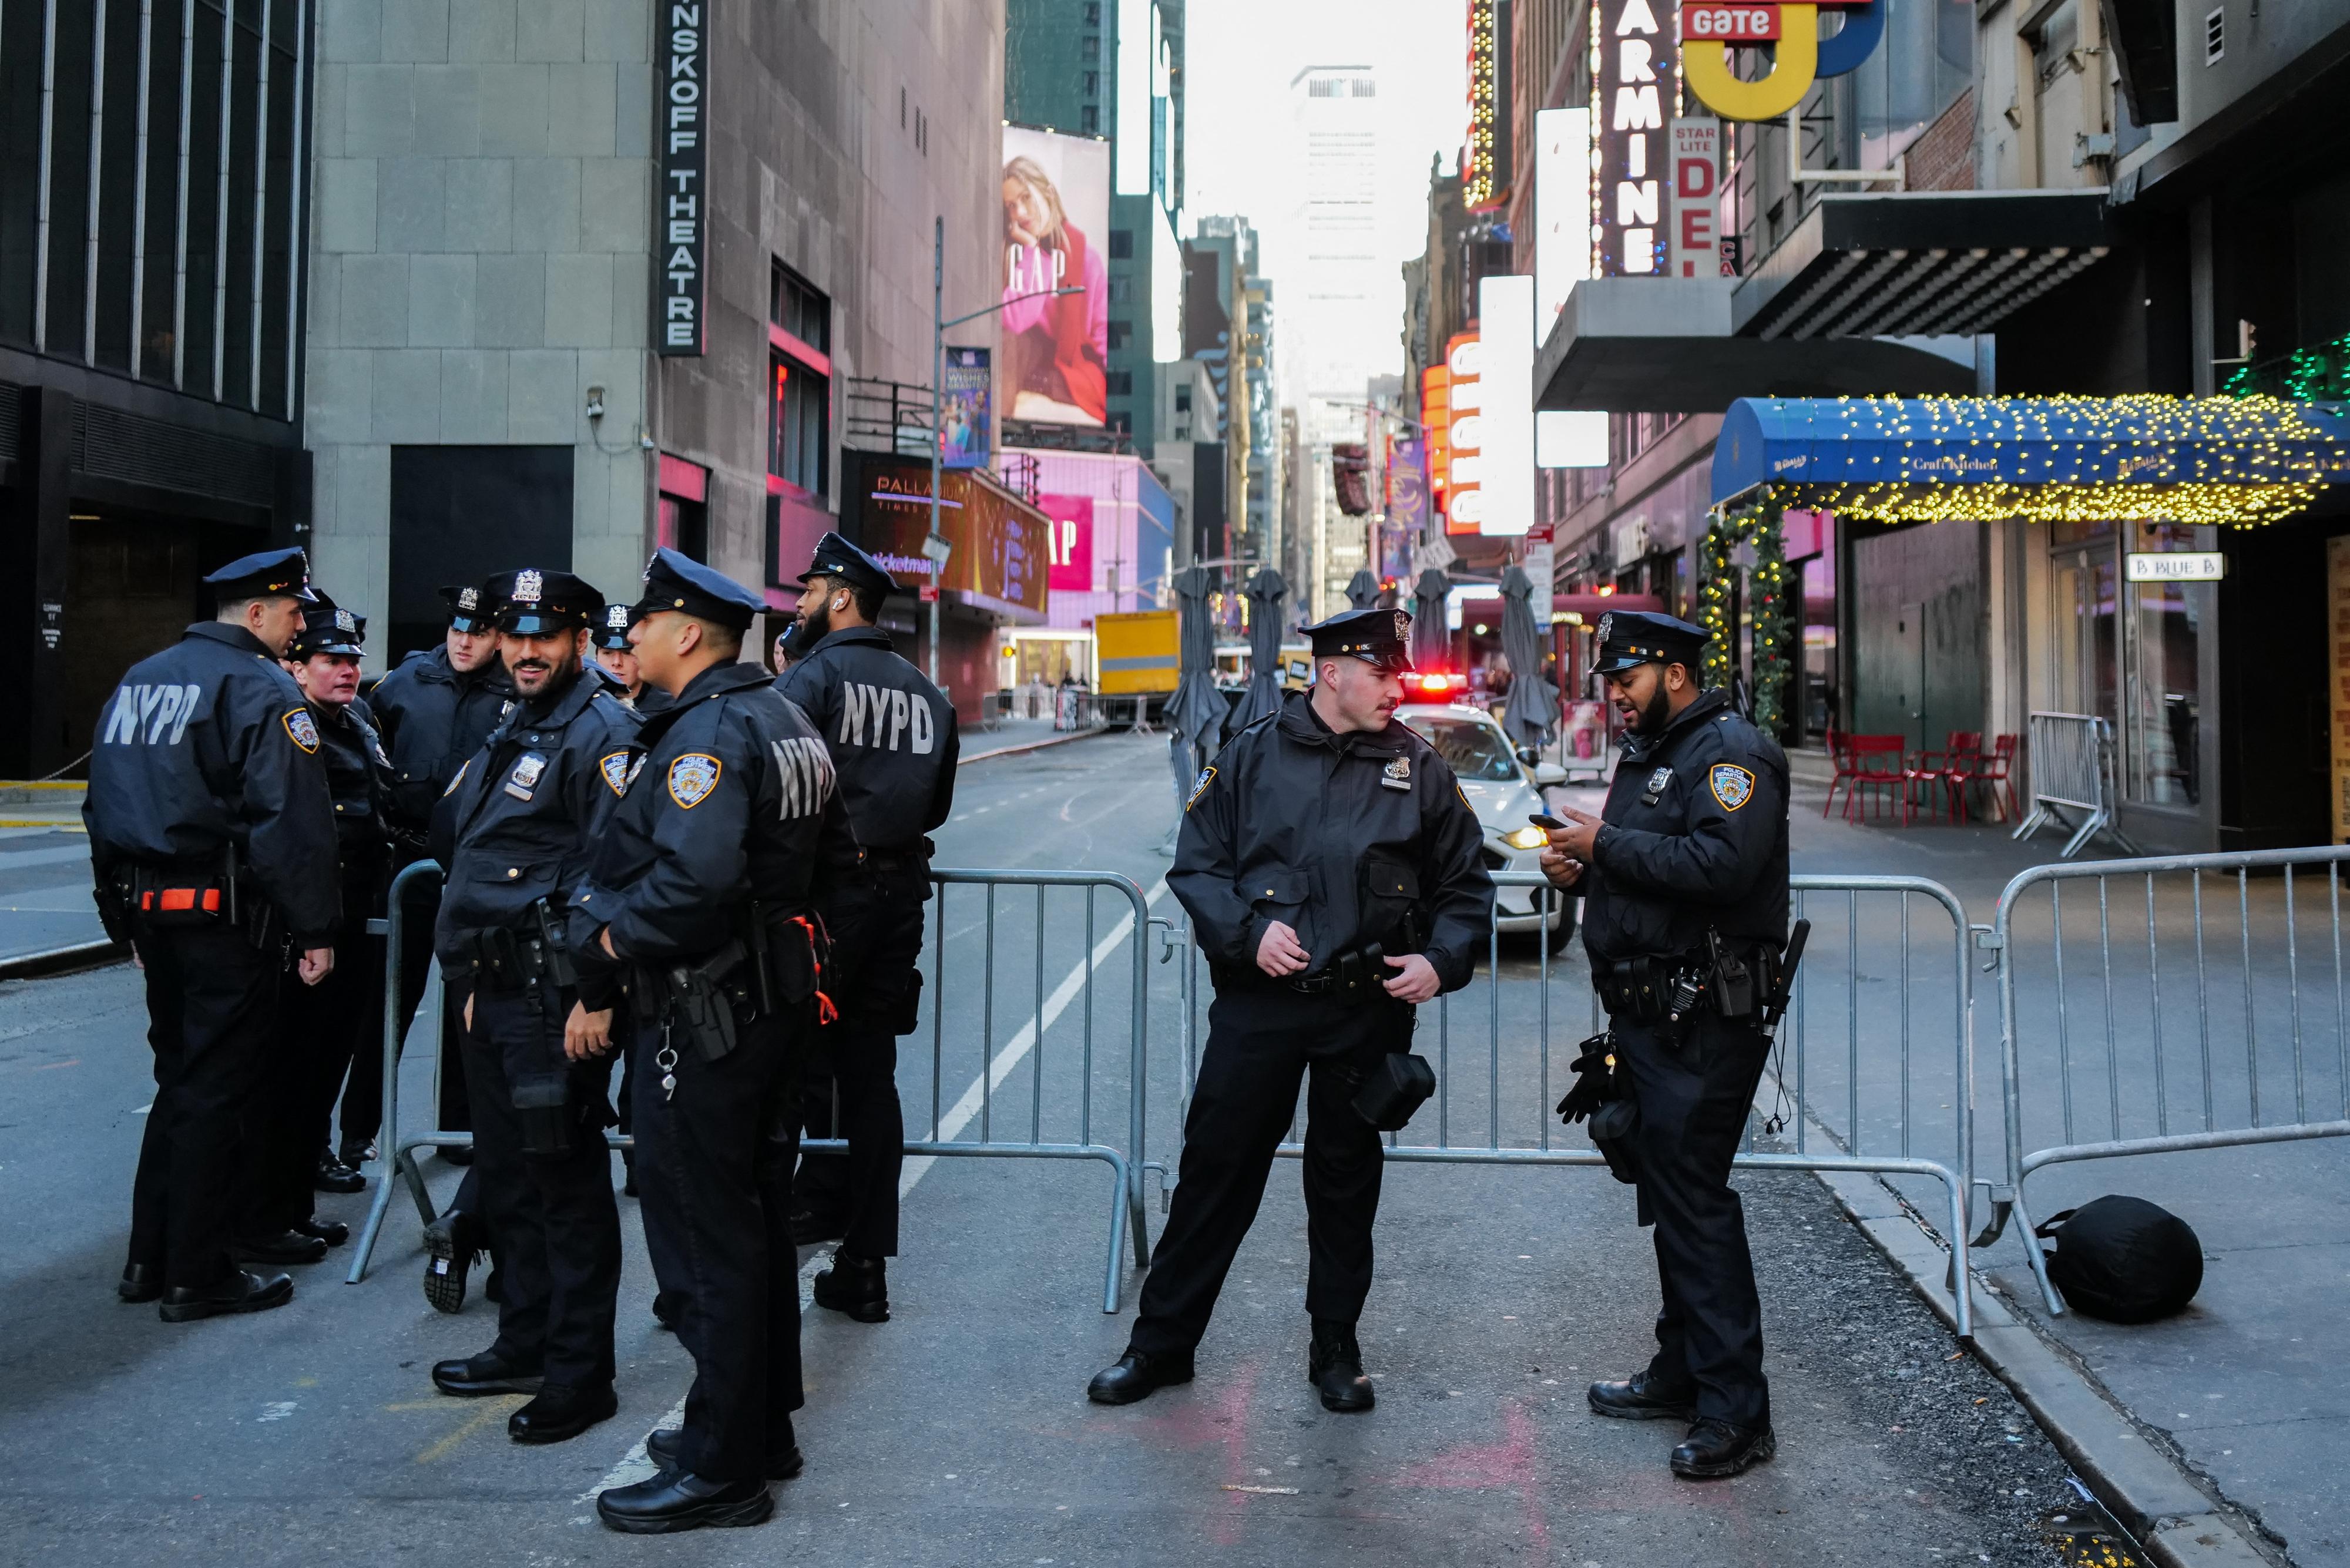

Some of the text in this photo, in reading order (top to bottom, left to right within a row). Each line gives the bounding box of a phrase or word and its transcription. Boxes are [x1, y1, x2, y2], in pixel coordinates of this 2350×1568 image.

[1676, 127, 1716, 139] STAR
[1680, 142, 1711, 152] LITE
[667, 0, 699, 346] NSKOFF THEATRE
[1010, 243, 1065, 297] GAP
[948, 373, 991, 382] WISHES
[1913, 455, 1998, 471] Craft Kitchen
[2156, 560, 2194, 577] BLUE
[103, 684, 201, 745] NYPD
[839, 681, 934, 754] NYPD
[673, 762, 717, 774] DEPARTMENT
[1724, 767, 1745, 777] POLICE
[770, 737, 837, 821] NYPD
[1716, 771, 1751, 786] DEPARTMENT
[676, 791, 684, 799] OF
[690, 777, 715, 803] NEW YORK
[1733, 788, 1750, 806] NEW YORK
